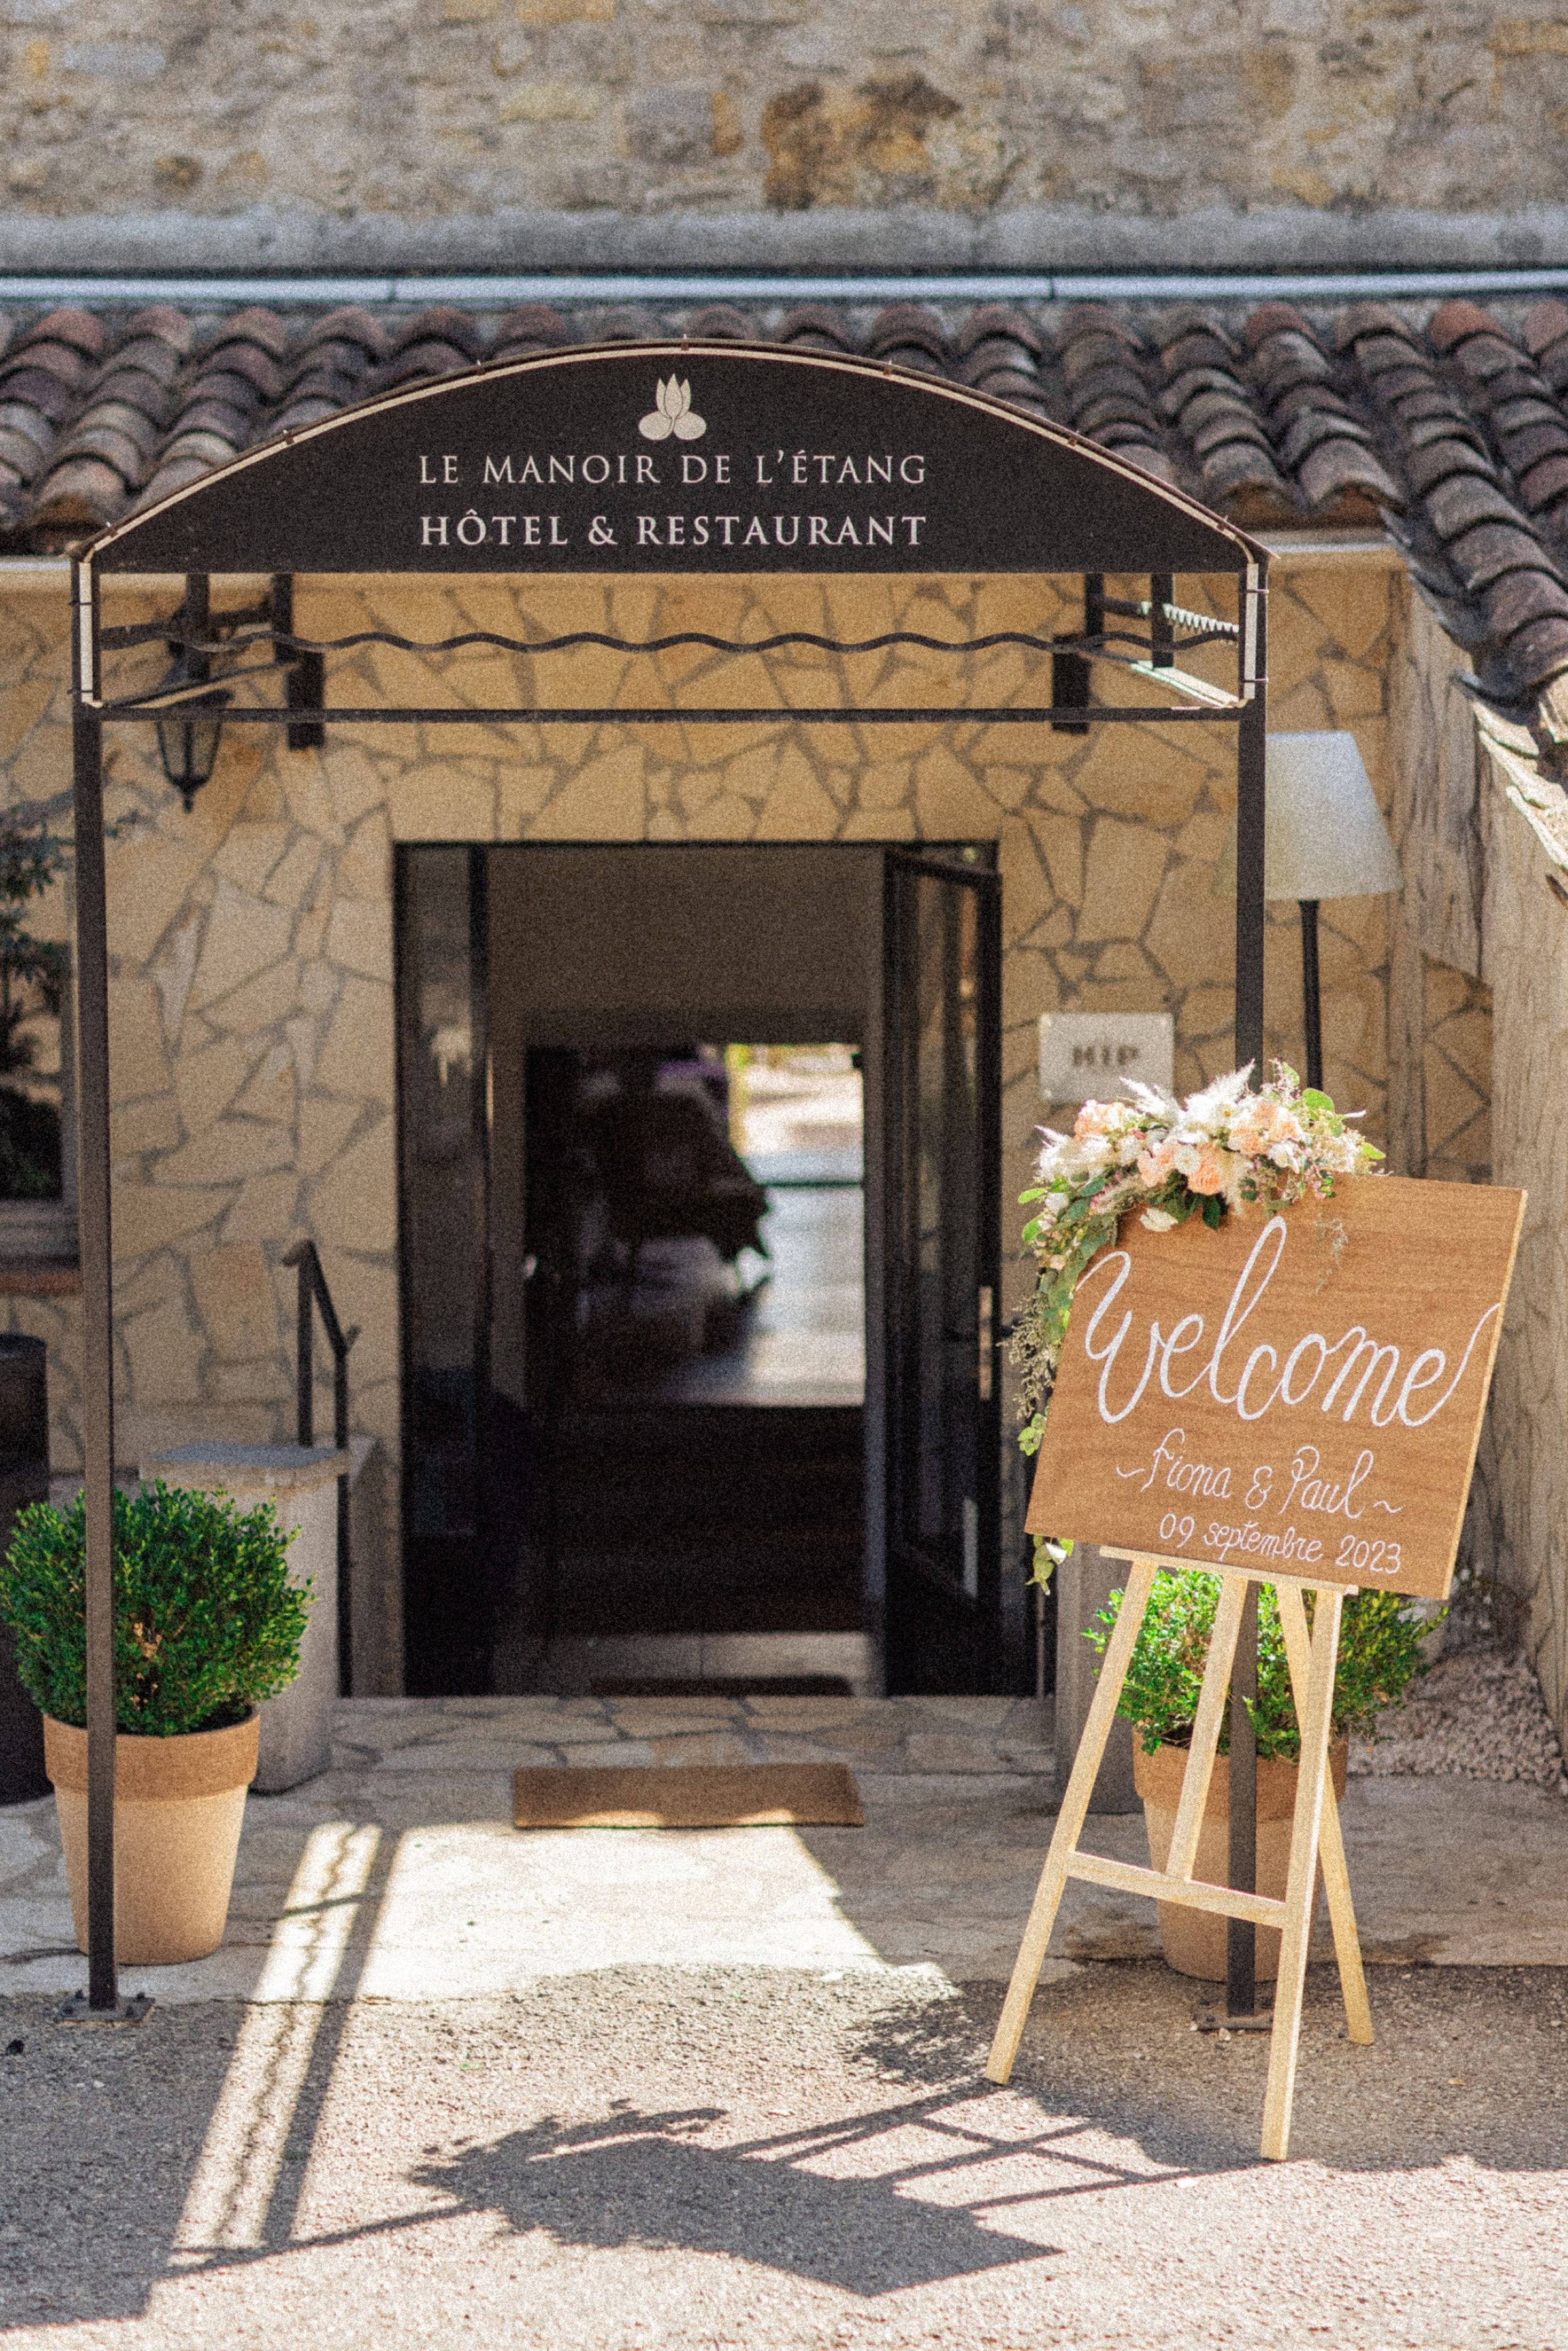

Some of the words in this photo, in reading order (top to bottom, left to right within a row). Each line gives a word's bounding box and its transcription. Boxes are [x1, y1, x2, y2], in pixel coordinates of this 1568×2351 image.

[419, 455, 459, 484] LE
[483, 455, 661, 484] MANOIR
[681, 455, 730, 484] DE
[420, 509, 568, 546] HÔTEL
[588, 516, 618, 546] &
[637, 516, 926, 546] RESTAURANT
[1074, 1215, 1502, 1427] Welcome
[1139, 1427, 1232, 1498] Fiona
[1244, 1465, 1273, 1510] &
[1278, 1445, 1375, 1520] Paul
[1158, 1512, 1196, 1549] 09
[1202, 1520, 1324, 1563] septembre
[1334, 1534, 1403, 1575] 2023
